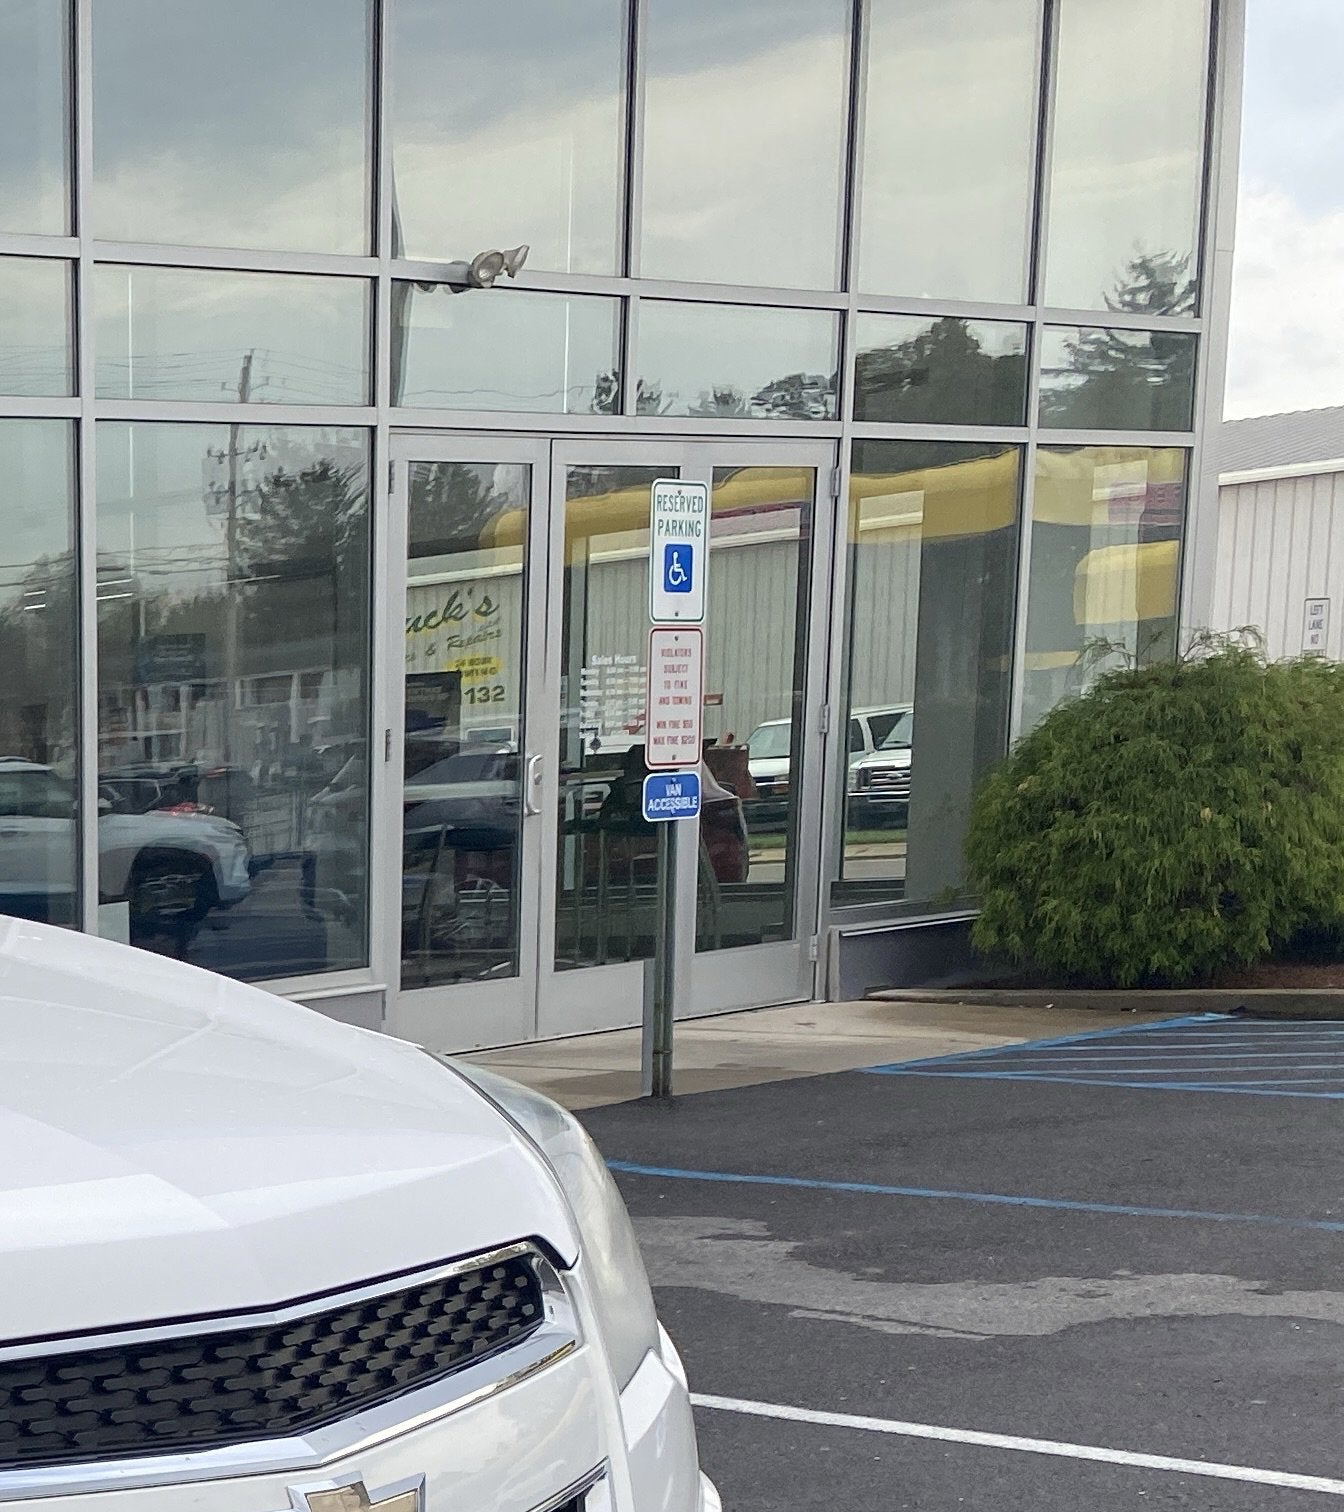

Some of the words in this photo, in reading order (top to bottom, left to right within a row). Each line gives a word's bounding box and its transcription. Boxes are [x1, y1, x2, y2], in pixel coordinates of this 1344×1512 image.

[657, 494, 704, 513] RESERVED
[657, 518, 702, 538] PARKING
[406, 587, 500, 633] uck's
[661, 648, 692, 657] VIOLATORS
[464, 685, 505, 704] 132
[666, 783, 682, 796] VAN
[647, 796, 698, 811] ACCESSIBLE
